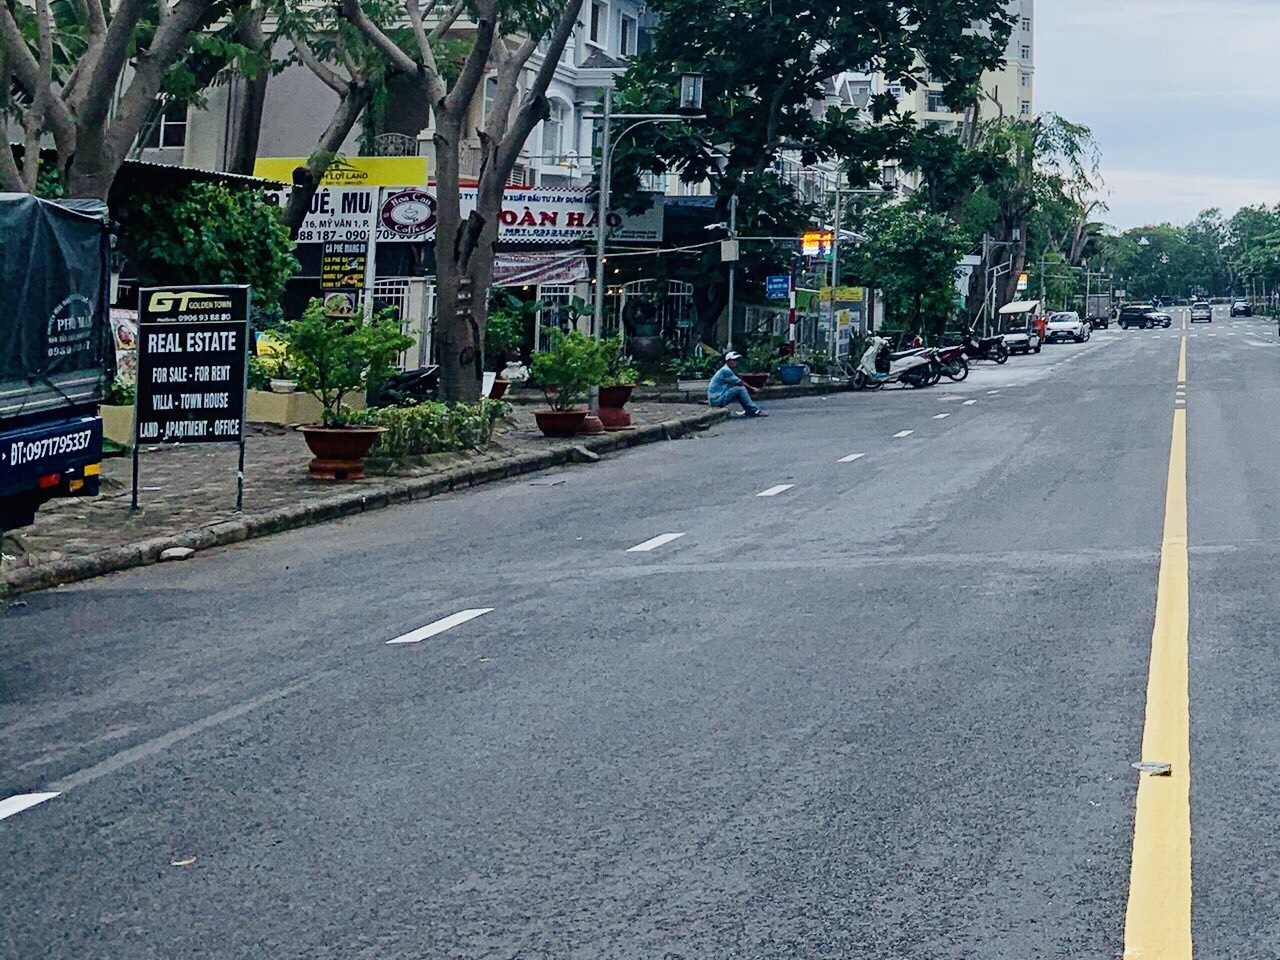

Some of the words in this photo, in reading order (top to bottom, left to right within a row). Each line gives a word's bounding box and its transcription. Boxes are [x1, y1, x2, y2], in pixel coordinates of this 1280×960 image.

[346, 172, 369, 180] LAND
[341, 192, 372, 214] MU
[500, 206, 559, 227] OÀN
[316, 230, 336, 241] 187
[394, 224, 426, 233] Coffee
[188, 301, 214, 310] GOLDEN
[214, 300, 232, 309] TOWN
[178, 313, 198, 322] 0906
[198, 313, 209, 322] 93
[210, 313, 220, 321] 88
[148, 332, 183, 353] REAL
[186, 331, 237, 352] ESTATE
[152, 367, 167, 383] FOR
[169, 366, 188, 383] SALE
[194, 365, 210, 381] FOR
[211, 365, 231, 381] RENT
[152, 394, 173, 410] VILLA
[180, 393, 202, 409] TOWN
[203, 392, 229, 409] HOUSE
[140, 421, 159, 438] LAND
[165, 420, 208, 438] APARTMENT
[214, 419, 240, 435] OFFICE
